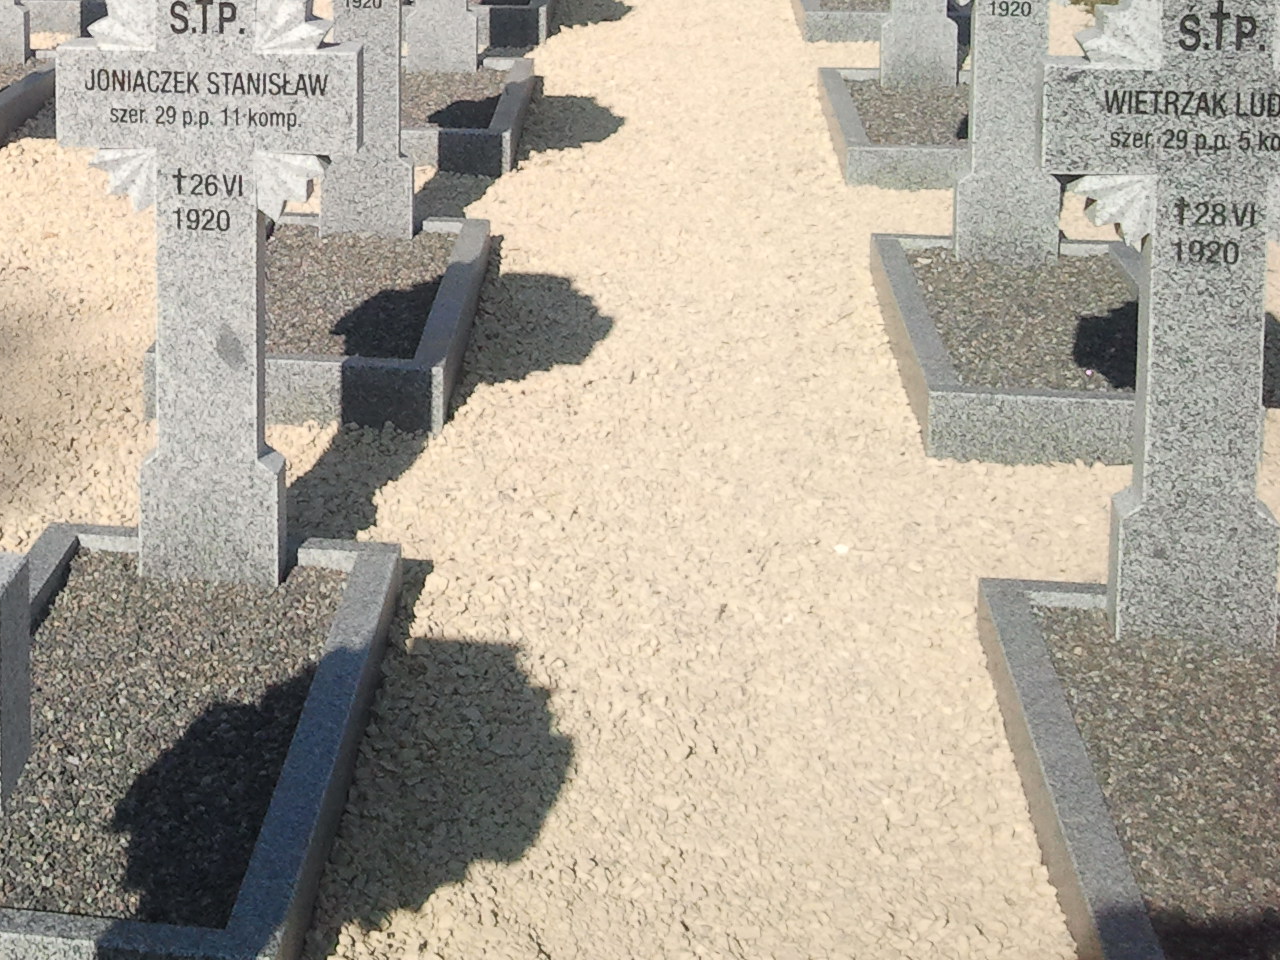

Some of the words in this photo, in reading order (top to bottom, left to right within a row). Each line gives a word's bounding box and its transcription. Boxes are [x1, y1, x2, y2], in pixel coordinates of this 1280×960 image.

[990, 1, 1031, 17] 1920
[85, 69, 199, 95] JONIACZEK
[207, 71, 329, 97] STANISŁAW
[1104, 89, 1227, 117] WIETRZAK
[109, 106, 149, 124] szer.
[155, 106, 176, 125] 29
[182, 110, 213, 129] p.p.
[221, 108, 241, 126] 11
[247, 108, 302, 131] komp.
[1110, 130, 1153, 149] szer.
[1164, 129, 1188, 149] 29
[1196, 132, 1228, 151] p.p.
[1238, 131, 1252, 150] 5
[190, 173, 219, 198] 26
[222, 174, 244, 198] VI
[173, 209, 231, 232] 1920
[1196, 202, 1227, 227] 28
[1231, 203, 1257, 228] VI
[1174, 240, 1240, 266] 1920
